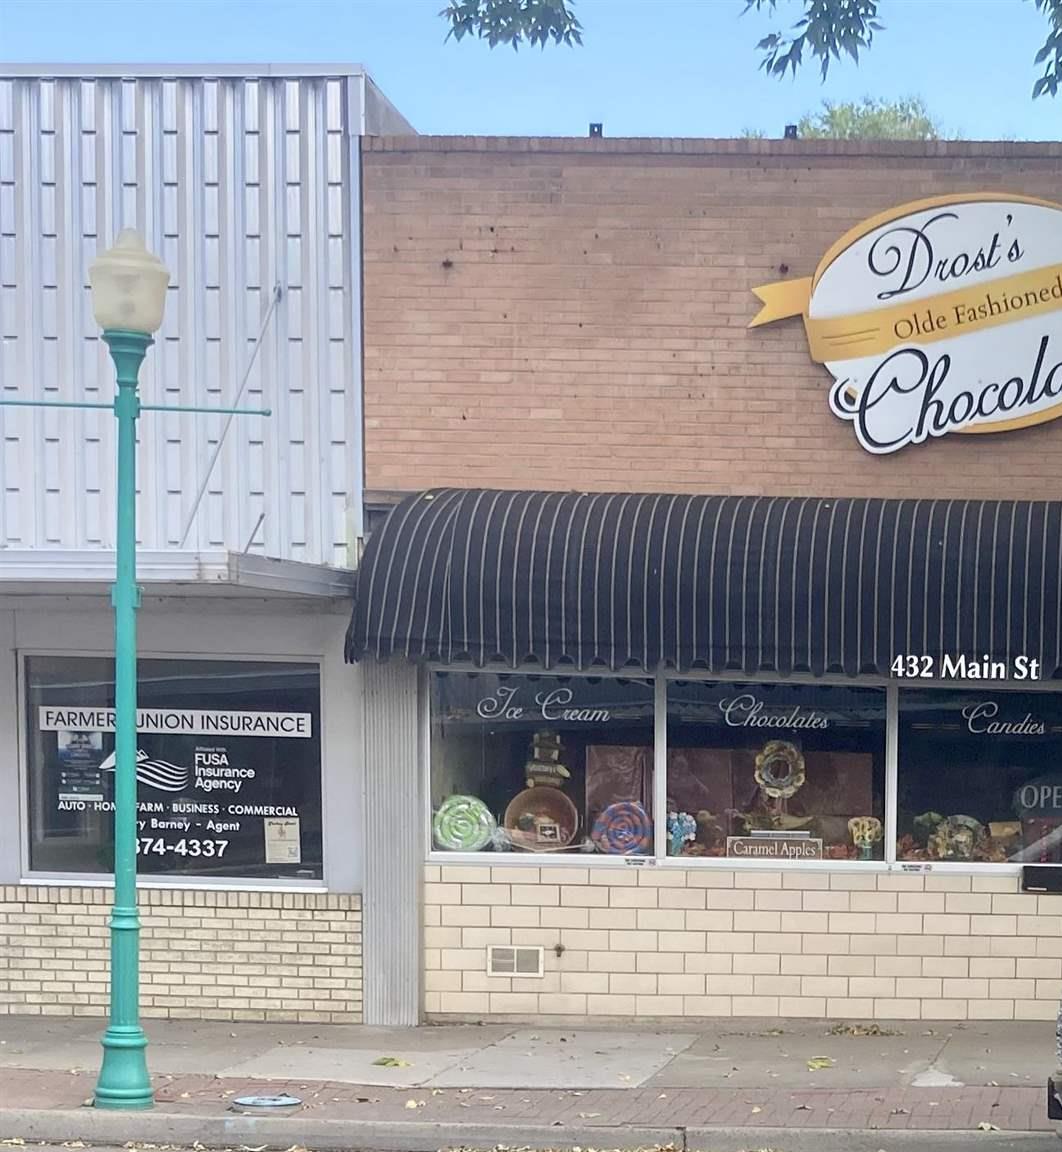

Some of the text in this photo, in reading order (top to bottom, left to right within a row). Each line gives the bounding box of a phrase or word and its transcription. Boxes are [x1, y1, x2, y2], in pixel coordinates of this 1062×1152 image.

[868, 213, 1024, 299] Drost's
[893, 315, 947, 341] Olde
[891, 655, 1040, 680] 432 Main St
[477, 687, 611, 722] Ice Cream
[719, 695, 830, 729] Chocolates
[46, 711, 115, 728] FARMER
[201, 716, 305, 733] INSURANCE
[961, 701, 1046, 735] Candies
[195, 753, 229, 766] FUSA
[195, 765, 256, 778] Insurance
[195, 776, 242, 793] Agency
[58, 801, 86, 811] AUTO
[93, 802, 117, 812] HOM
[172, 803, 220, 814] BUSINESS
[227, 805, 299, 817] COMMERCIAL
[151, 818, 191, 832] Barney
[206, 820, 240, 832] Agent
[733, 841, 816, 859] Caramel Apples
